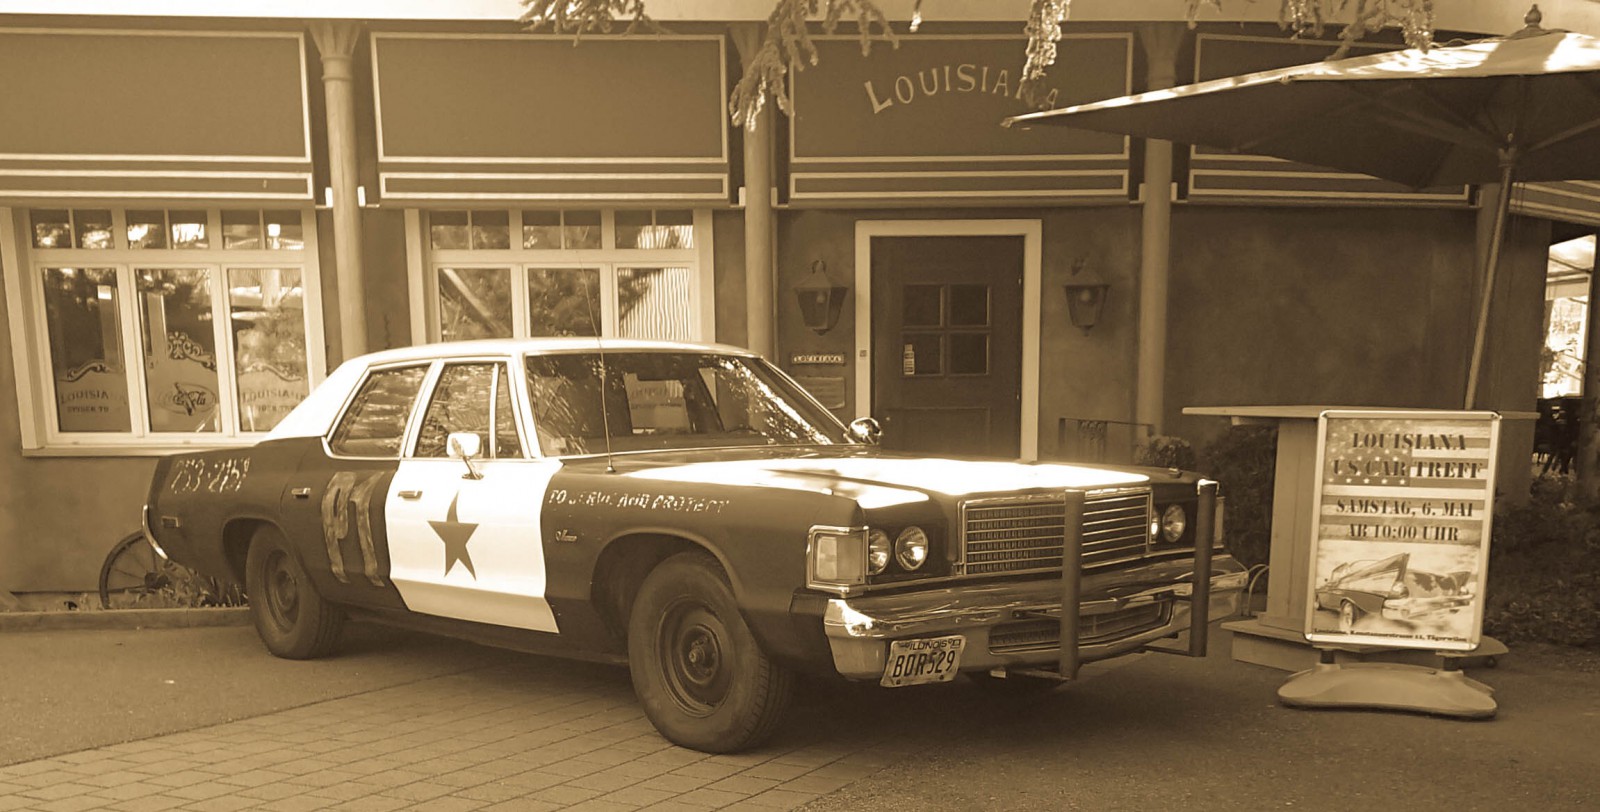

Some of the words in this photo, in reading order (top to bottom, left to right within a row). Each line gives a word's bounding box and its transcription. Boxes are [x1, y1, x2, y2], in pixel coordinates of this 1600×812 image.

[864, 63, 1059, 114] LOUISIAA
[1352, 432, 1466, 451] LOUISIANA
[1333, 459, 1358, 477] US
[1366, 459, 1406, 477] CAR
[1412, 460, 1483, 479] TREFF
[549, 489, 567, 504] TO
[1336, 499, 1416, 516] SAMSTAG,
[1421, 501, 1436, 516] 6.
[1442, 502, 1473, 517] MAI
[1349, 524, 1368, 538] AB
[1374, 524, 1417, 540] 10:00
[1423, 525, 1459, 542] UHR
